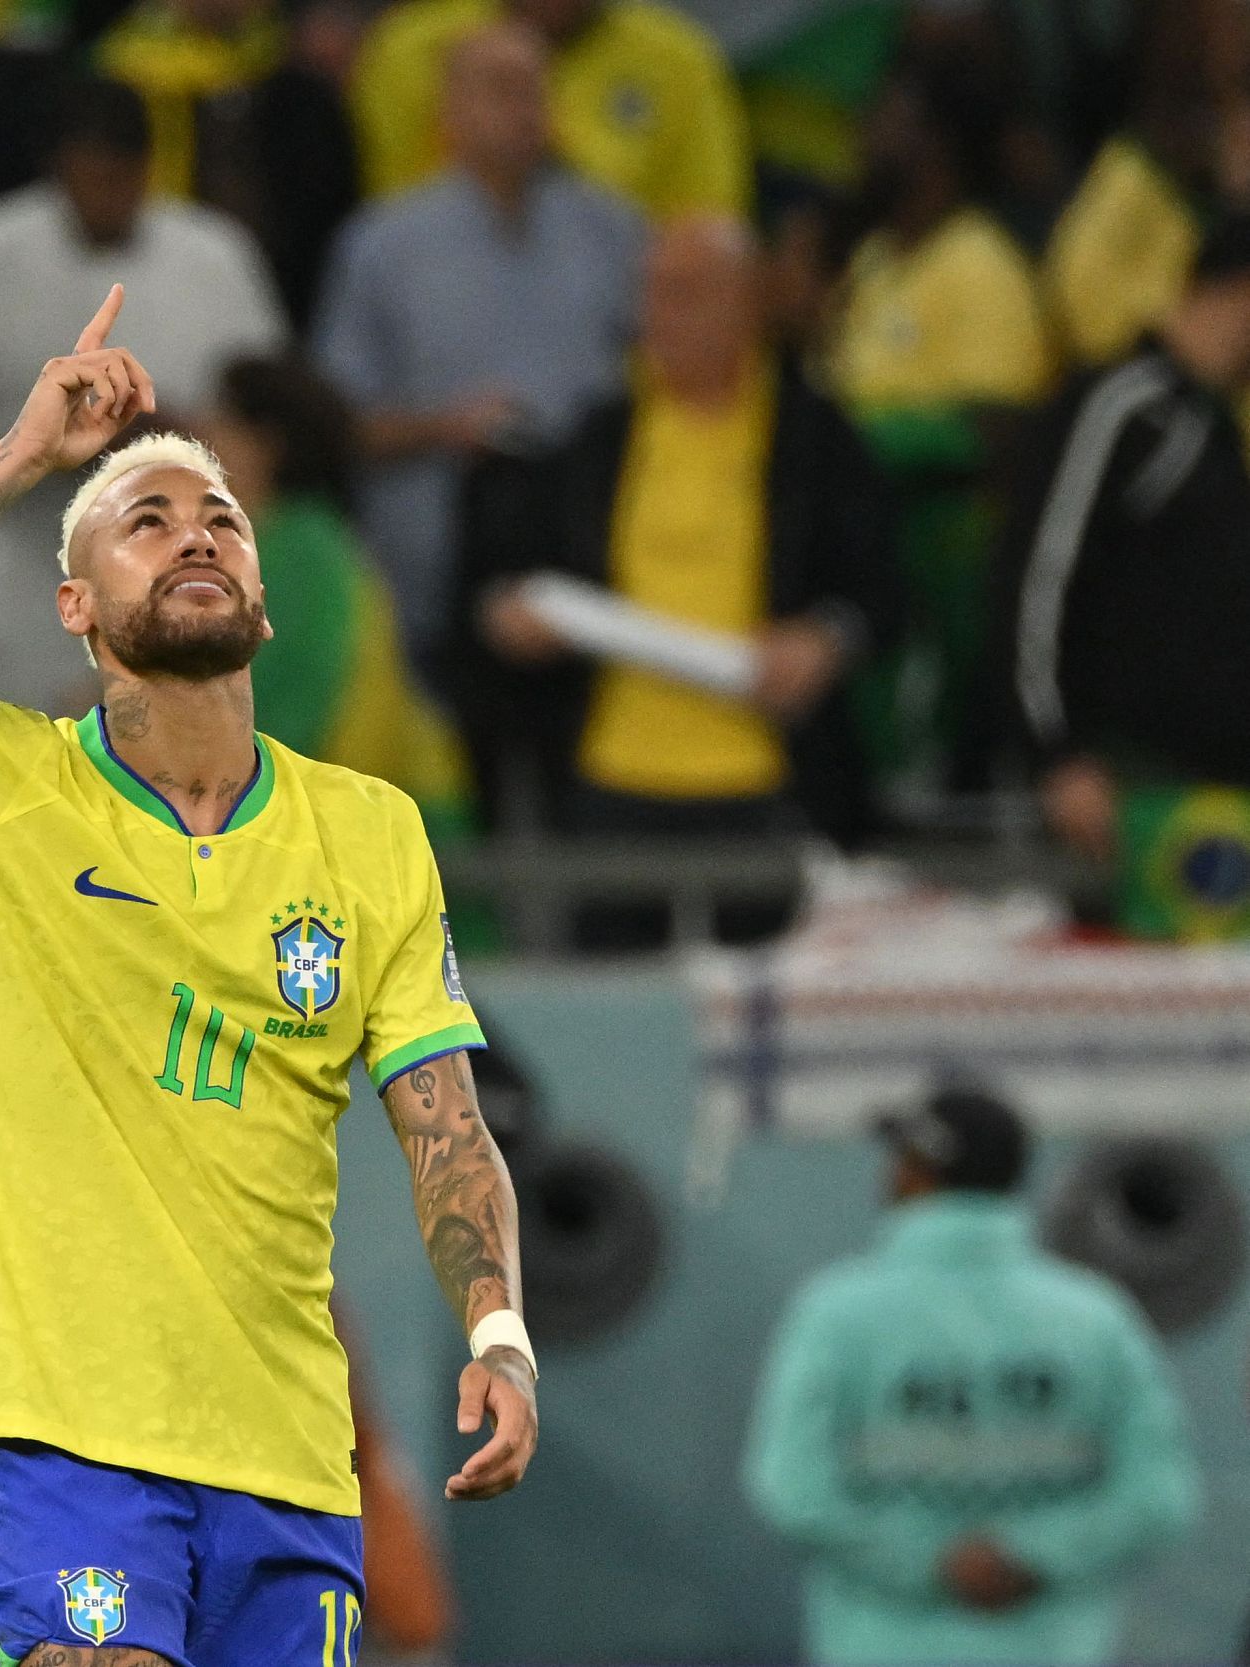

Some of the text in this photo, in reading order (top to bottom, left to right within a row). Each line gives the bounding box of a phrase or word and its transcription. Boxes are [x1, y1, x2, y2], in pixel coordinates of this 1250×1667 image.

[294, 958, 319, 972] CBF
[263, 1016, 329, 1039] BRASIL
[153, 982, 256, 1110] 10
[84, 1598, 106, 1607] CBF
